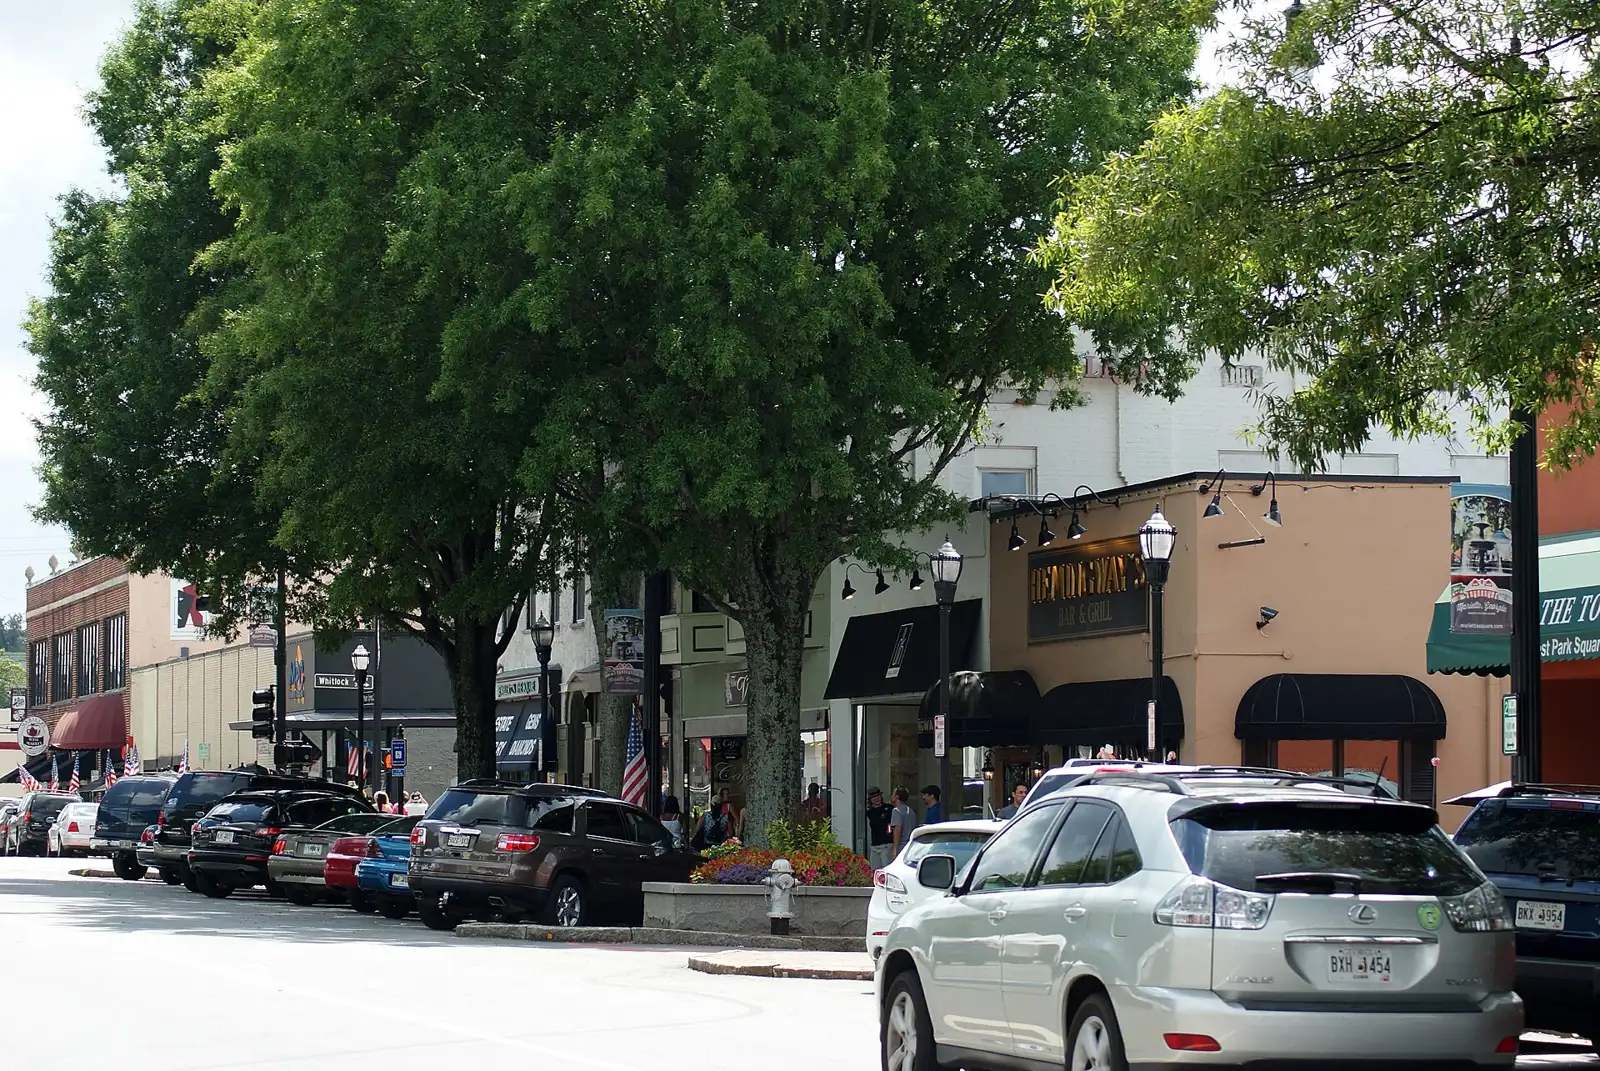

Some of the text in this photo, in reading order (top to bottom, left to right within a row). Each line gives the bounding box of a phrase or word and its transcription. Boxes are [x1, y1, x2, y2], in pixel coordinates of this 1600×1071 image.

[1058, 600, 1113, 627] BAR & GRILL
[1540, 596, 1577, 626] THE
[1551, 637, 1572, 656] Park
[319, 677, 349, 686] Whitlock
[1517, 907, 1534, 921] BKX
[1330, 955, 1353, 973] BXH
